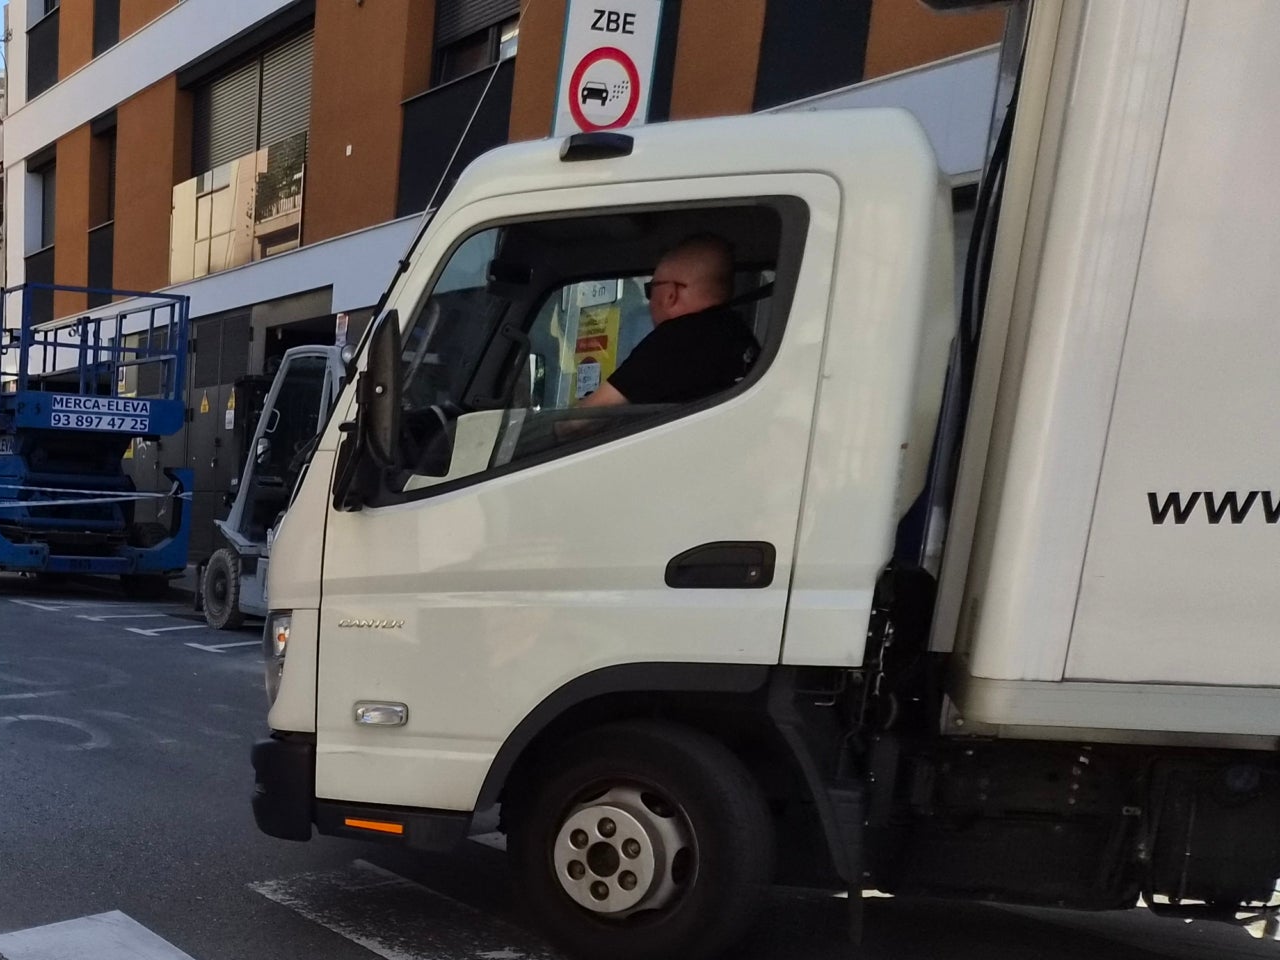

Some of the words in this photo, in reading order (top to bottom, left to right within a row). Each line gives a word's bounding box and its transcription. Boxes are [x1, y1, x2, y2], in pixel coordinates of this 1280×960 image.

[591, 8, 637, 35] ZBE
[52, 396, 149, 414] MERCA-ELEVA
[52, 413, 71, 426] 93
[75, 415, 103, 428] 897
[107, 417, 125, 429] 47
[130, 418, 148, 431] 25
